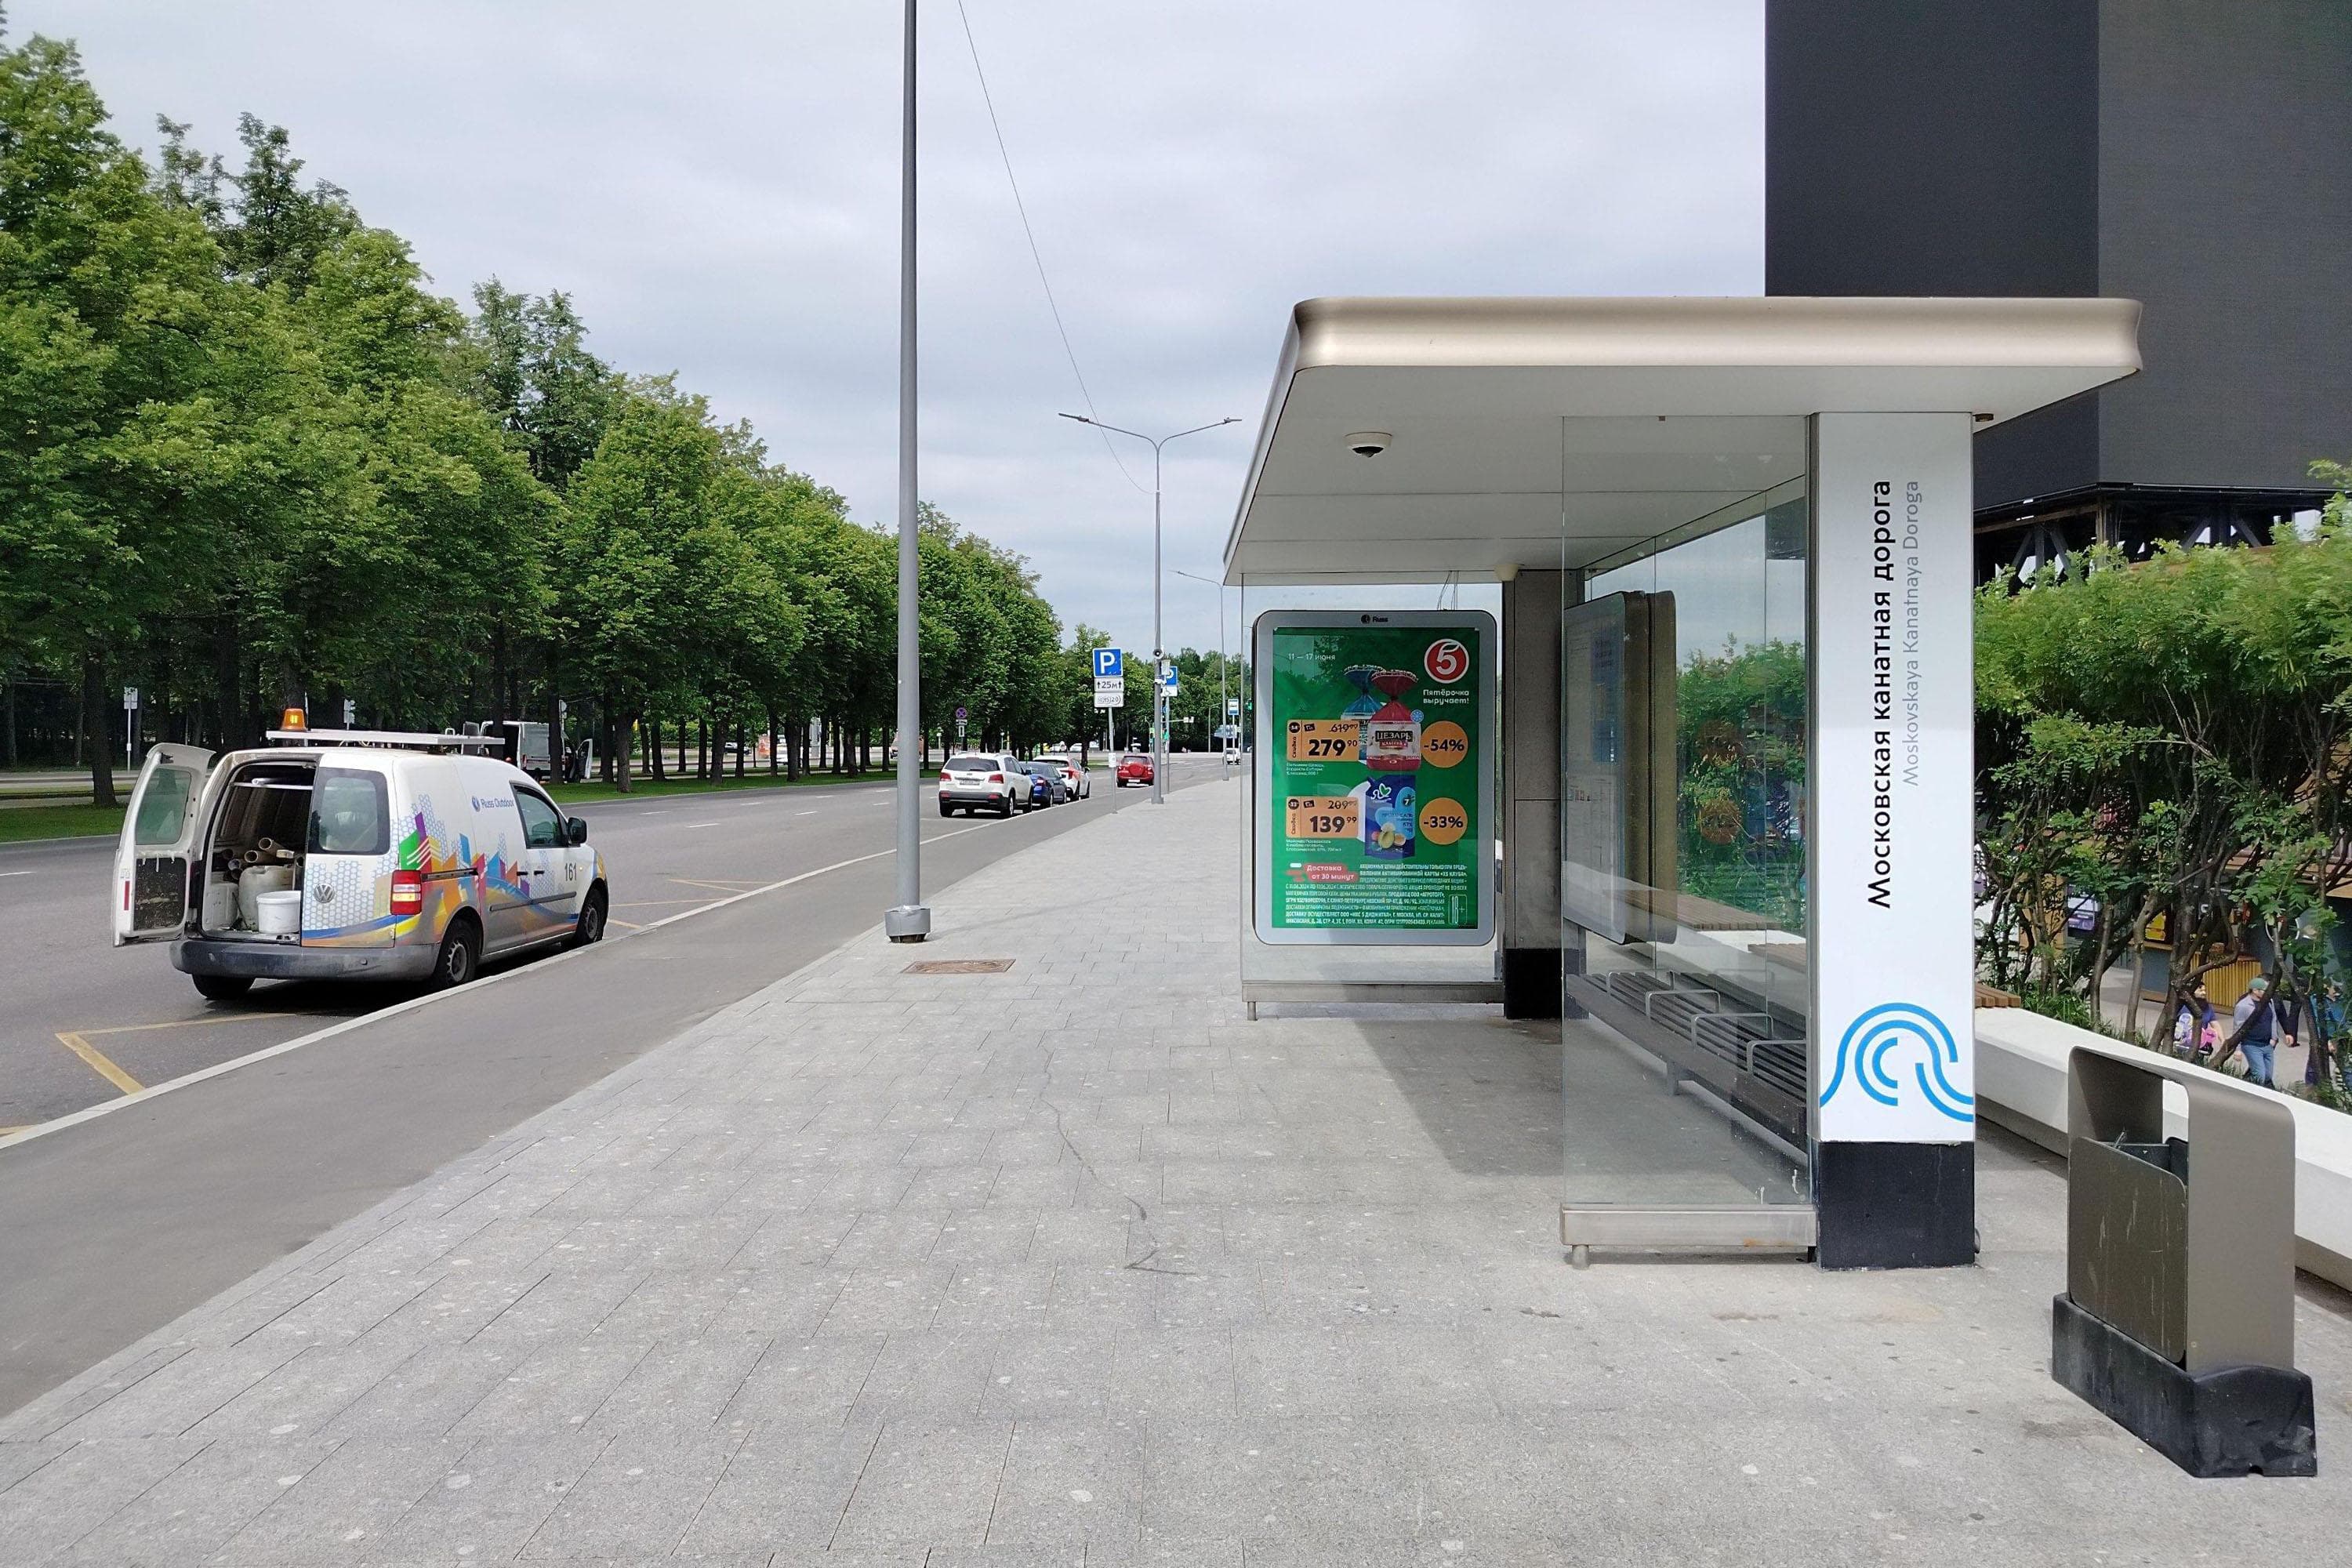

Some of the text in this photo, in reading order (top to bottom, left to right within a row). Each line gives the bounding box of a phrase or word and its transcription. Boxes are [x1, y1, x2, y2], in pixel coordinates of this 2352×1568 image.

[1902, 481, 1922, 786] Moskovskaya Kanatnaya Doroga
[1100, 652, 1116, 674] P
[1436, 642, 1460, 675] 5
[1423, 688, 1470, 697] Пятёрочка
[1868, 481, 1896, 909] Московская канатная дорога
[1377, 731, 1412, 741] ЦЕЗАРЬ
[1423, 739, 1465, 752] -54%
[1309, 815, 1345, 833] 139
[1423, 815, 1464, 829] -33%
[564, 862, 577, 882] 161
